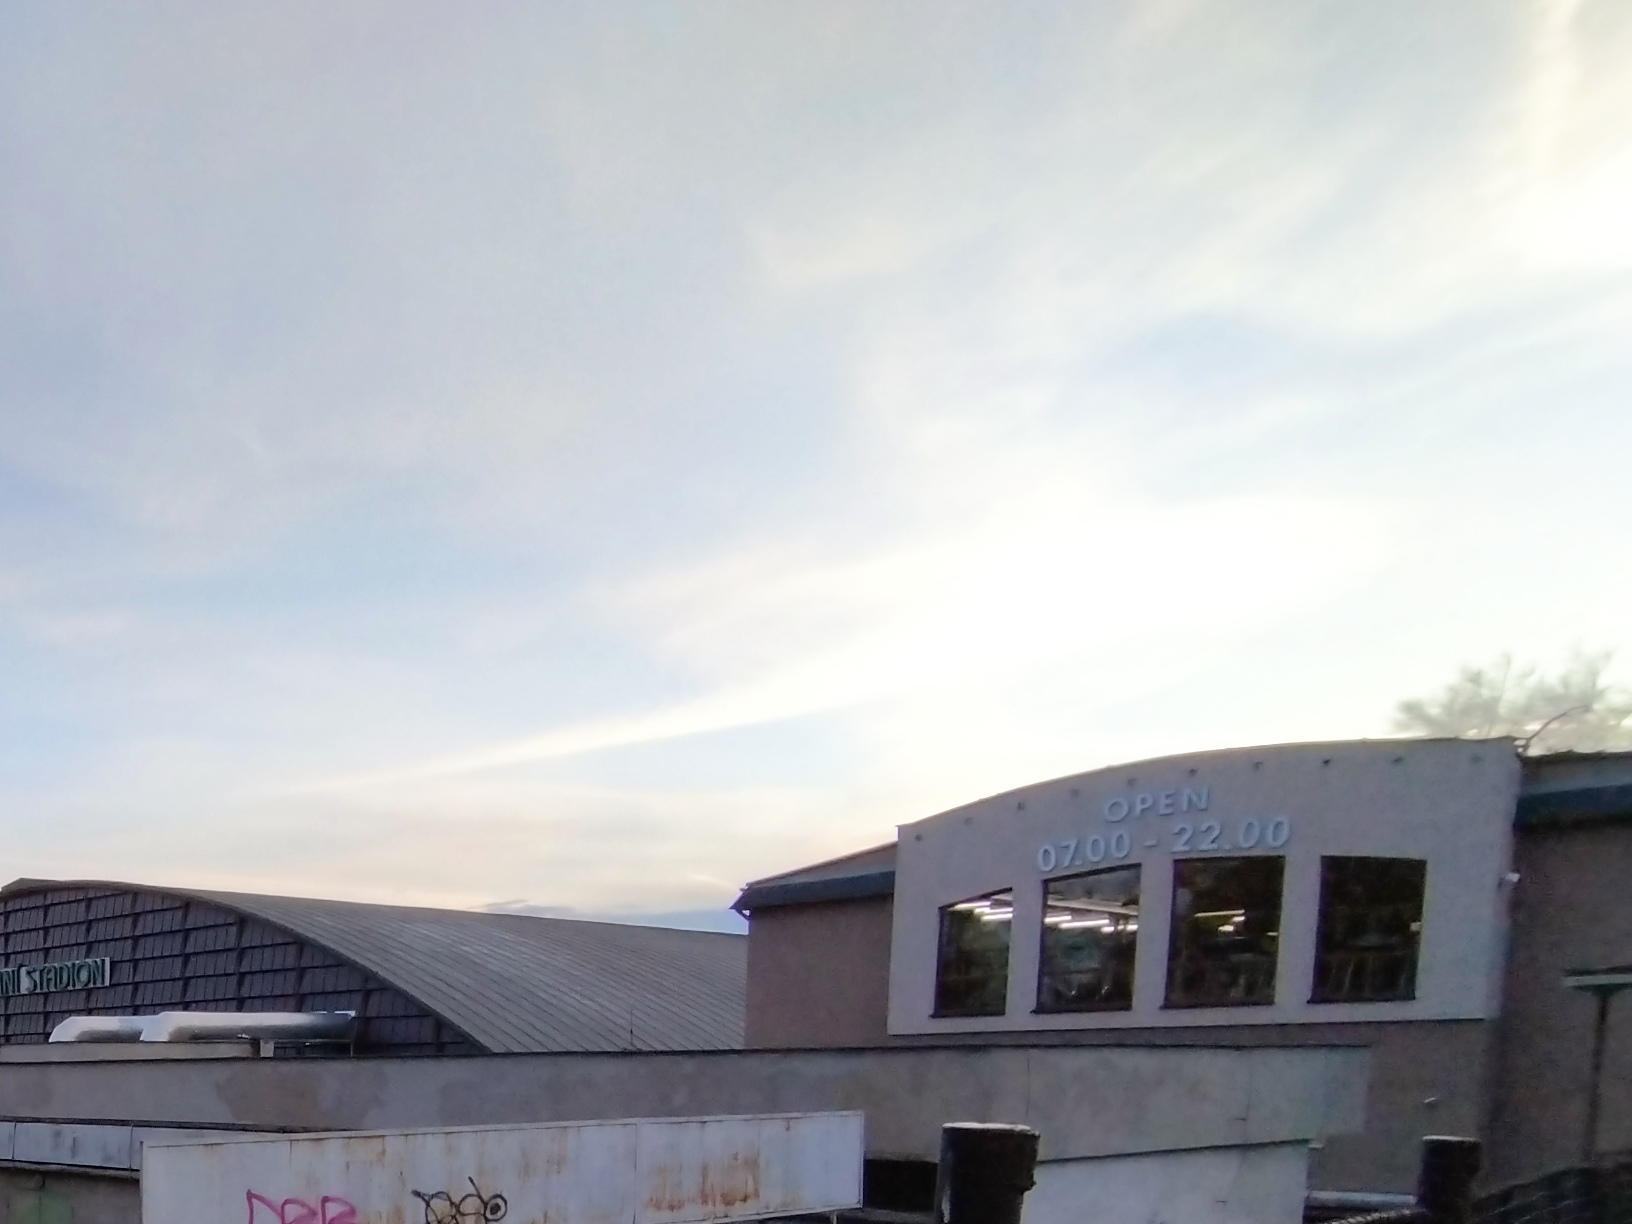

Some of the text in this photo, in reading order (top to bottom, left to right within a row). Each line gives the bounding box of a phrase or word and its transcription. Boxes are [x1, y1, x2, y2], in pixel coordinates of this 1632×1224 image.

[1104, 786, 1210, 823] OPEN
[1037, 830, 1132, 873] 07.00
[1169, 816, 1291, 853] 22.00
[24, 958, 106, 994] STADION
